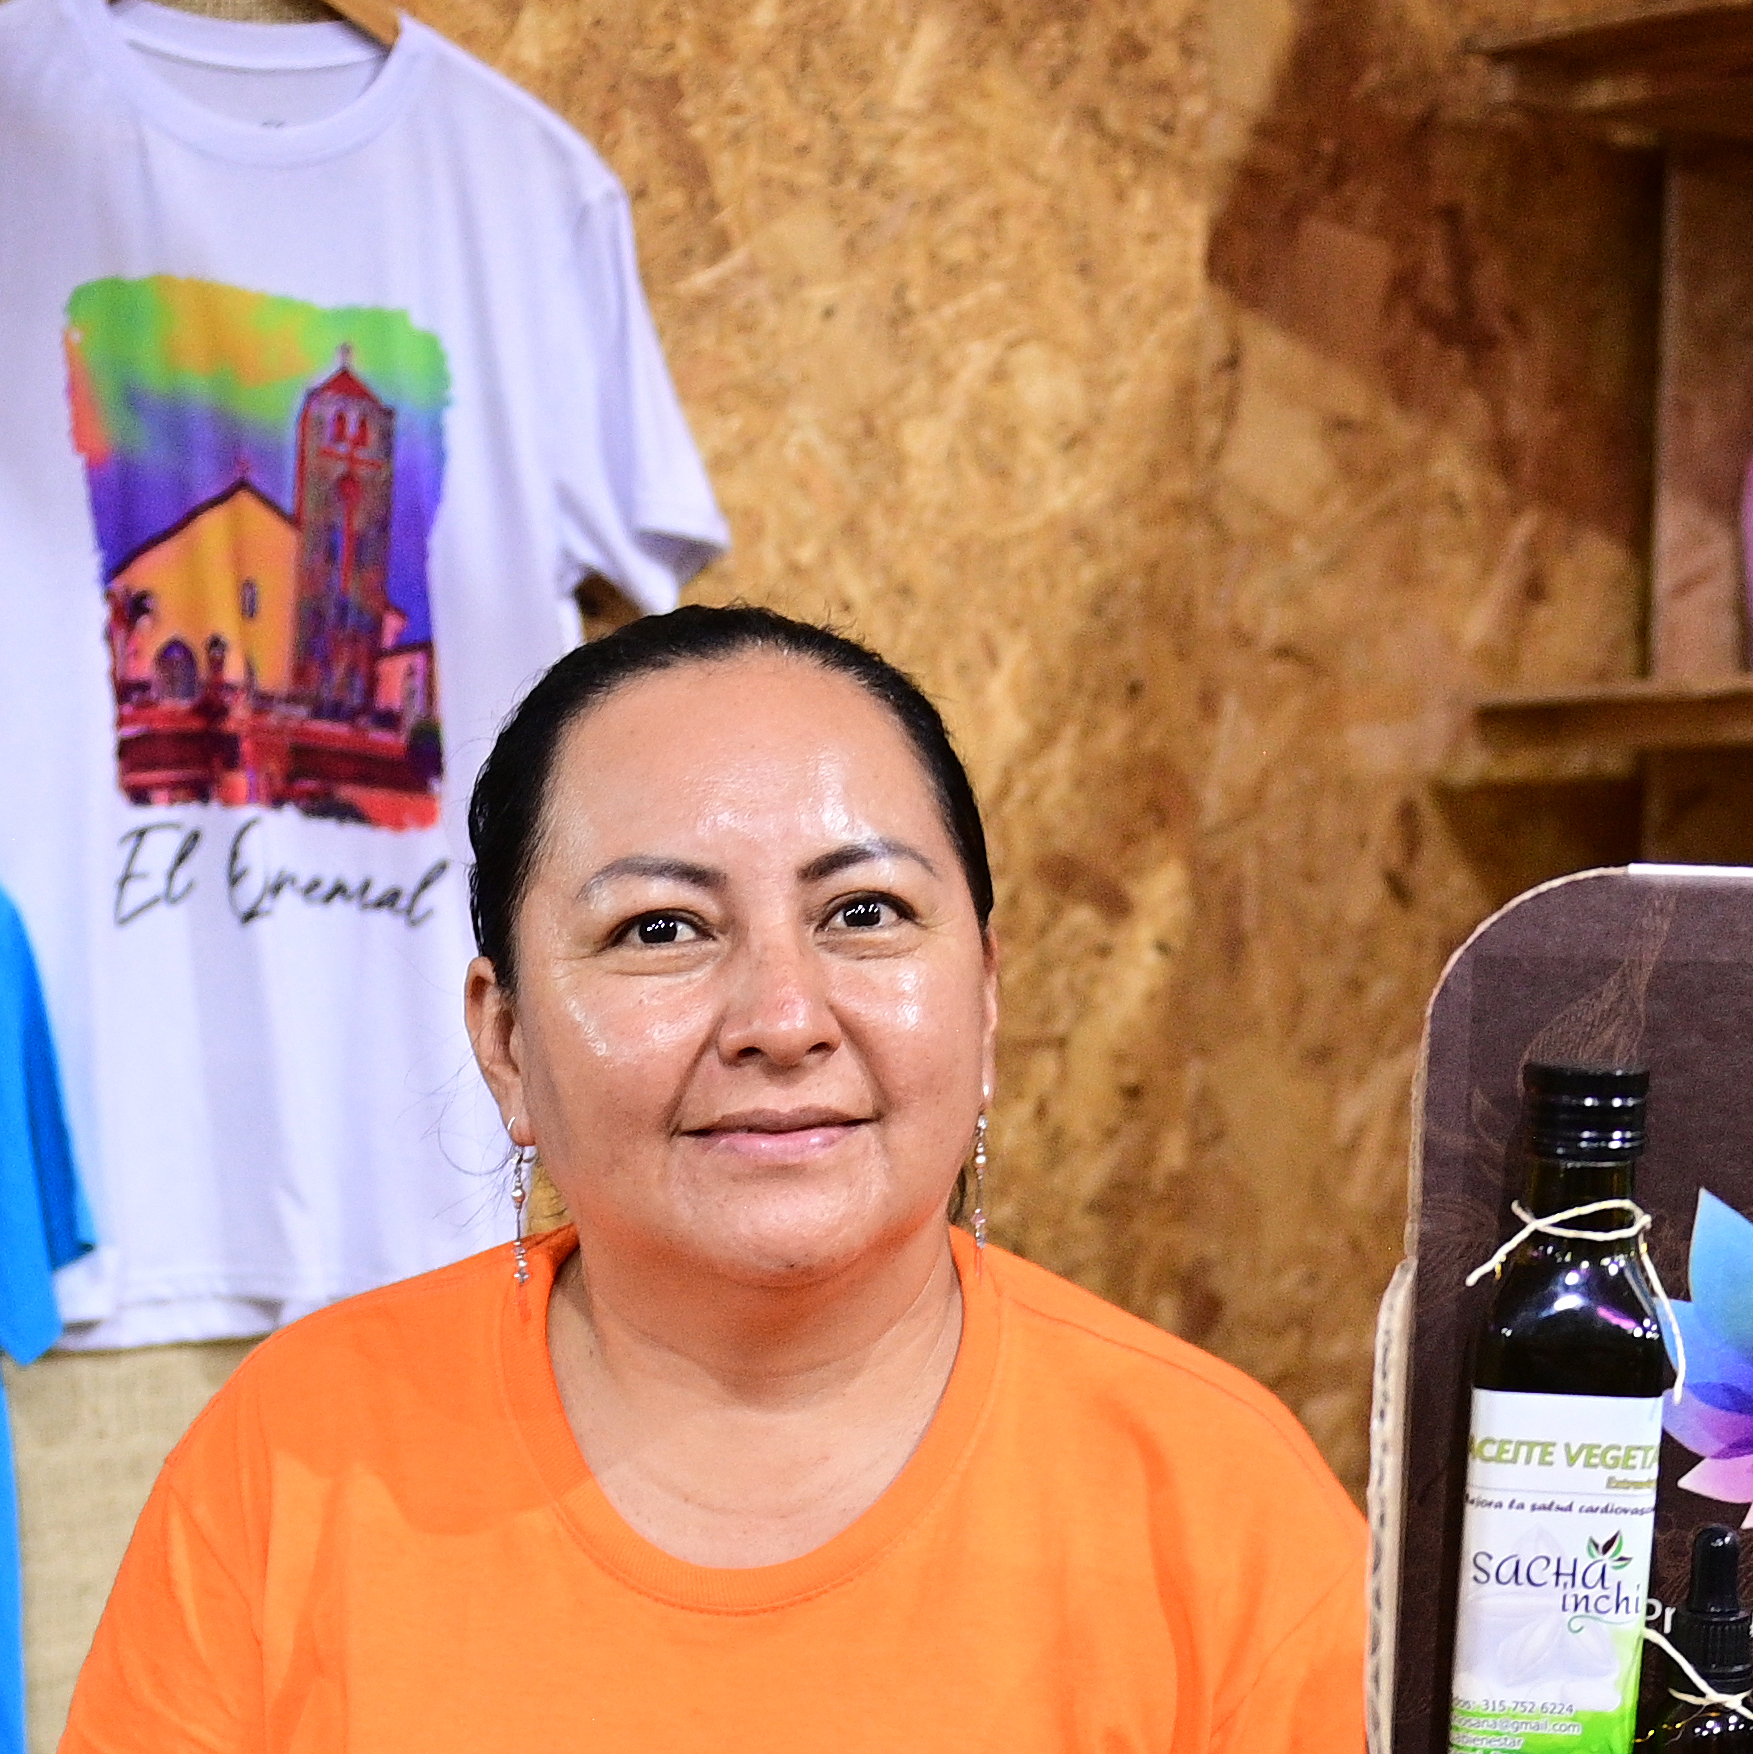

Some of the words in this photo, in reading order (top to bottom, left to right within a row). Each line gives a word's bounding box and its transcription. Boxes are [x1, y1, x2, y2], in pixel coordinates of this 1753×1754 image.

[114, 822, 201, 926] El
[1564, 1442, 1659, 1470] VEGETA
[1562, 1581, 1642, 1616] inchi
[1513, 1701, 1536, 1713] 752
[1541, 1702, 1574, 1715] 6224
